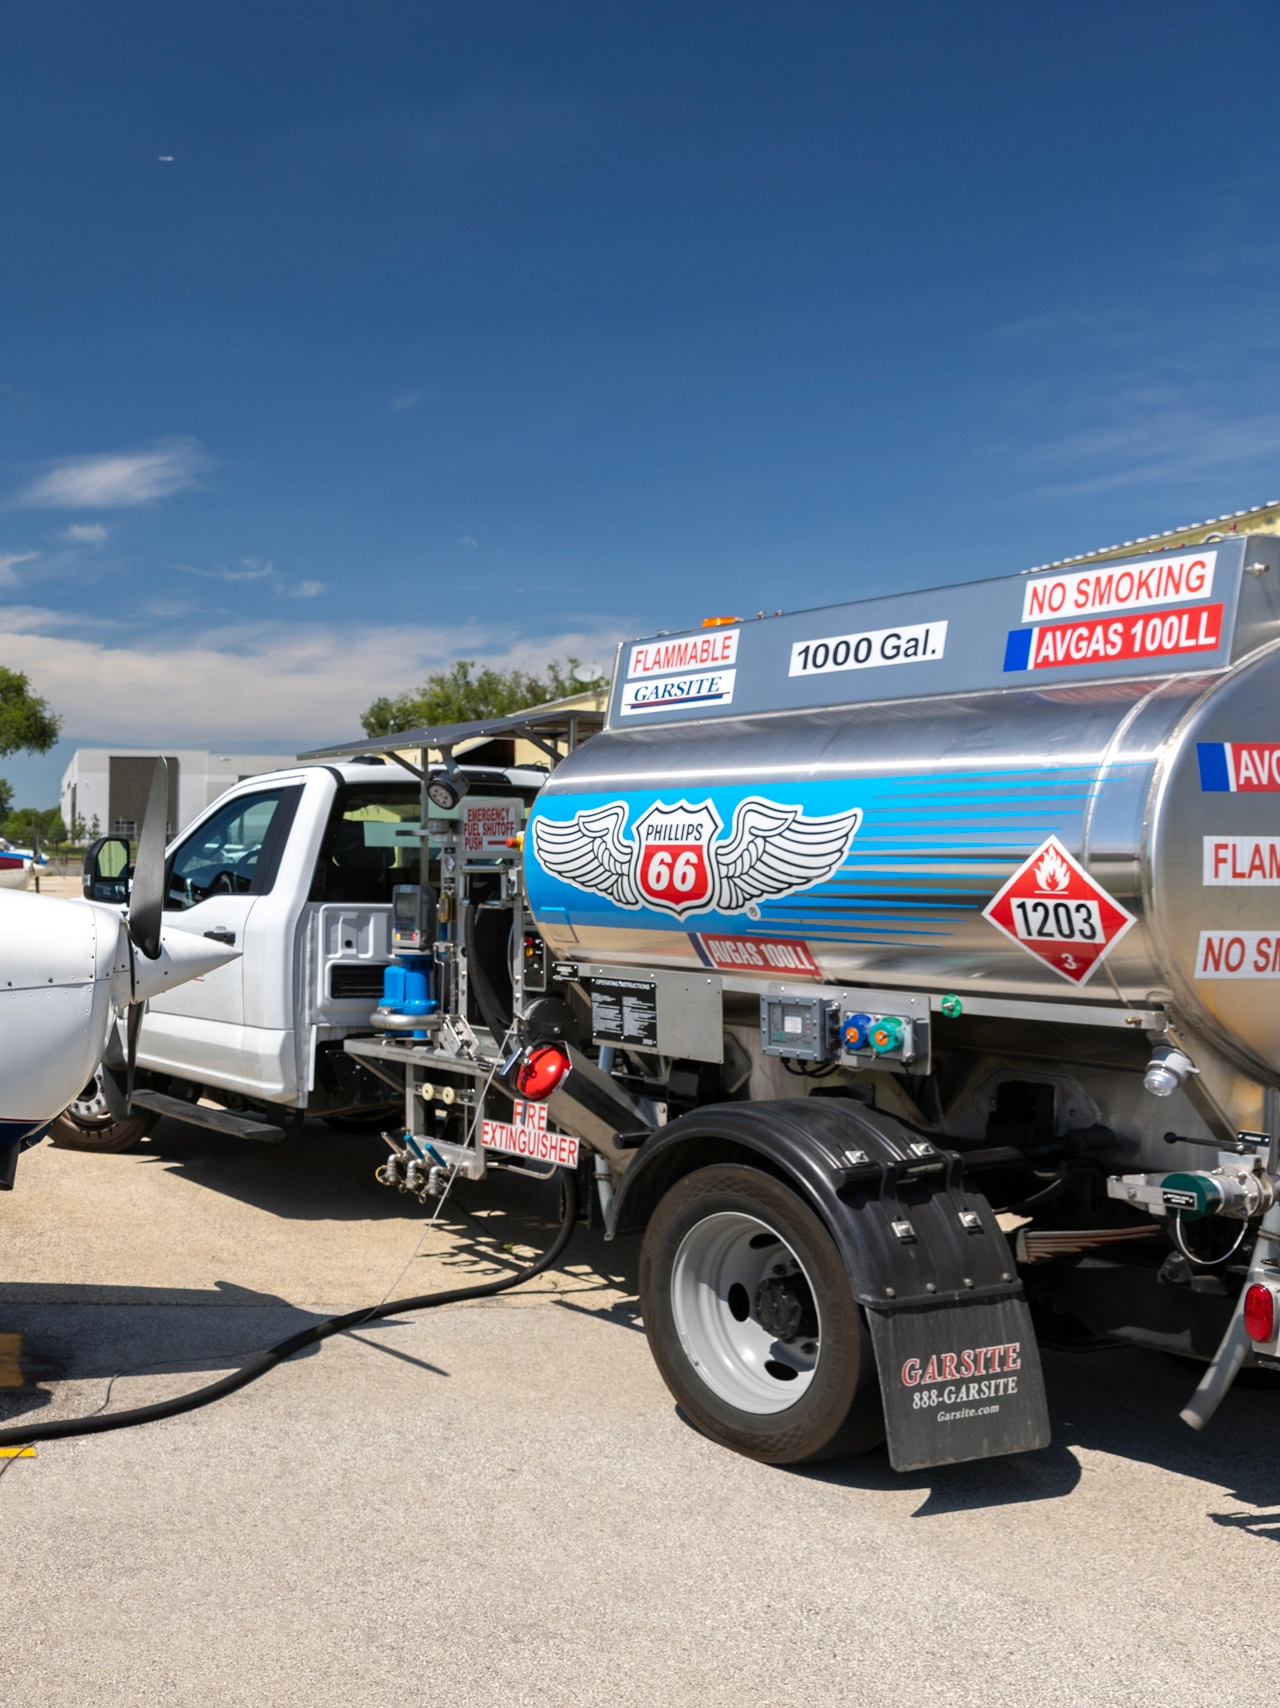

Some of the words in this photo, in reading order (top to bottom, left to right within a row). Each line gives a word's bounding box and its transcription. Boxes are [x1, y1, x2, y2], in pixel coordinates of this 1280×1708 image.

[1028, 582, 1067, 616] NO
[1074, 560, 1206, 609] SMOKING
[633, 635, 733, 674] FLAMMABLE
[797, 637, 872, 670] 1000
[880, 628, 936, 660] Gal.
[1035, 622, 1124, 664] AVGAS
[1130, 611, 1217, 653] 100LL
[634, 676, 722, 702] GARSITE
[464, 822, 481, 836] FUEL
[482, 821, 515, 836] SHUTOFF
[467, 807, 510, 823] EMERGENCY
[645, 823, 704, 841] PHILLIPS
[464, 836, 483, 851] PUSH
[647, 851, 699, 892] 66
[1016, 901, 1097, 941] 1203
[707, 940, 765, 966] AVGAS
[759, 943, 816, 970] 100LL
[1060, 952, 1078, 970] 3
[1202, 936, 1246, 973] NO
[513, 1101, 547, 1132] FIRE
[481, 1121, 577, 1166] EXTINGUISHER
[901, 1342, 1022, 1387] GARSITE
[912, 1376, 1018, 1410] 888-GARSITE
[936, 1404, 1000, 1422] Garsite.com
